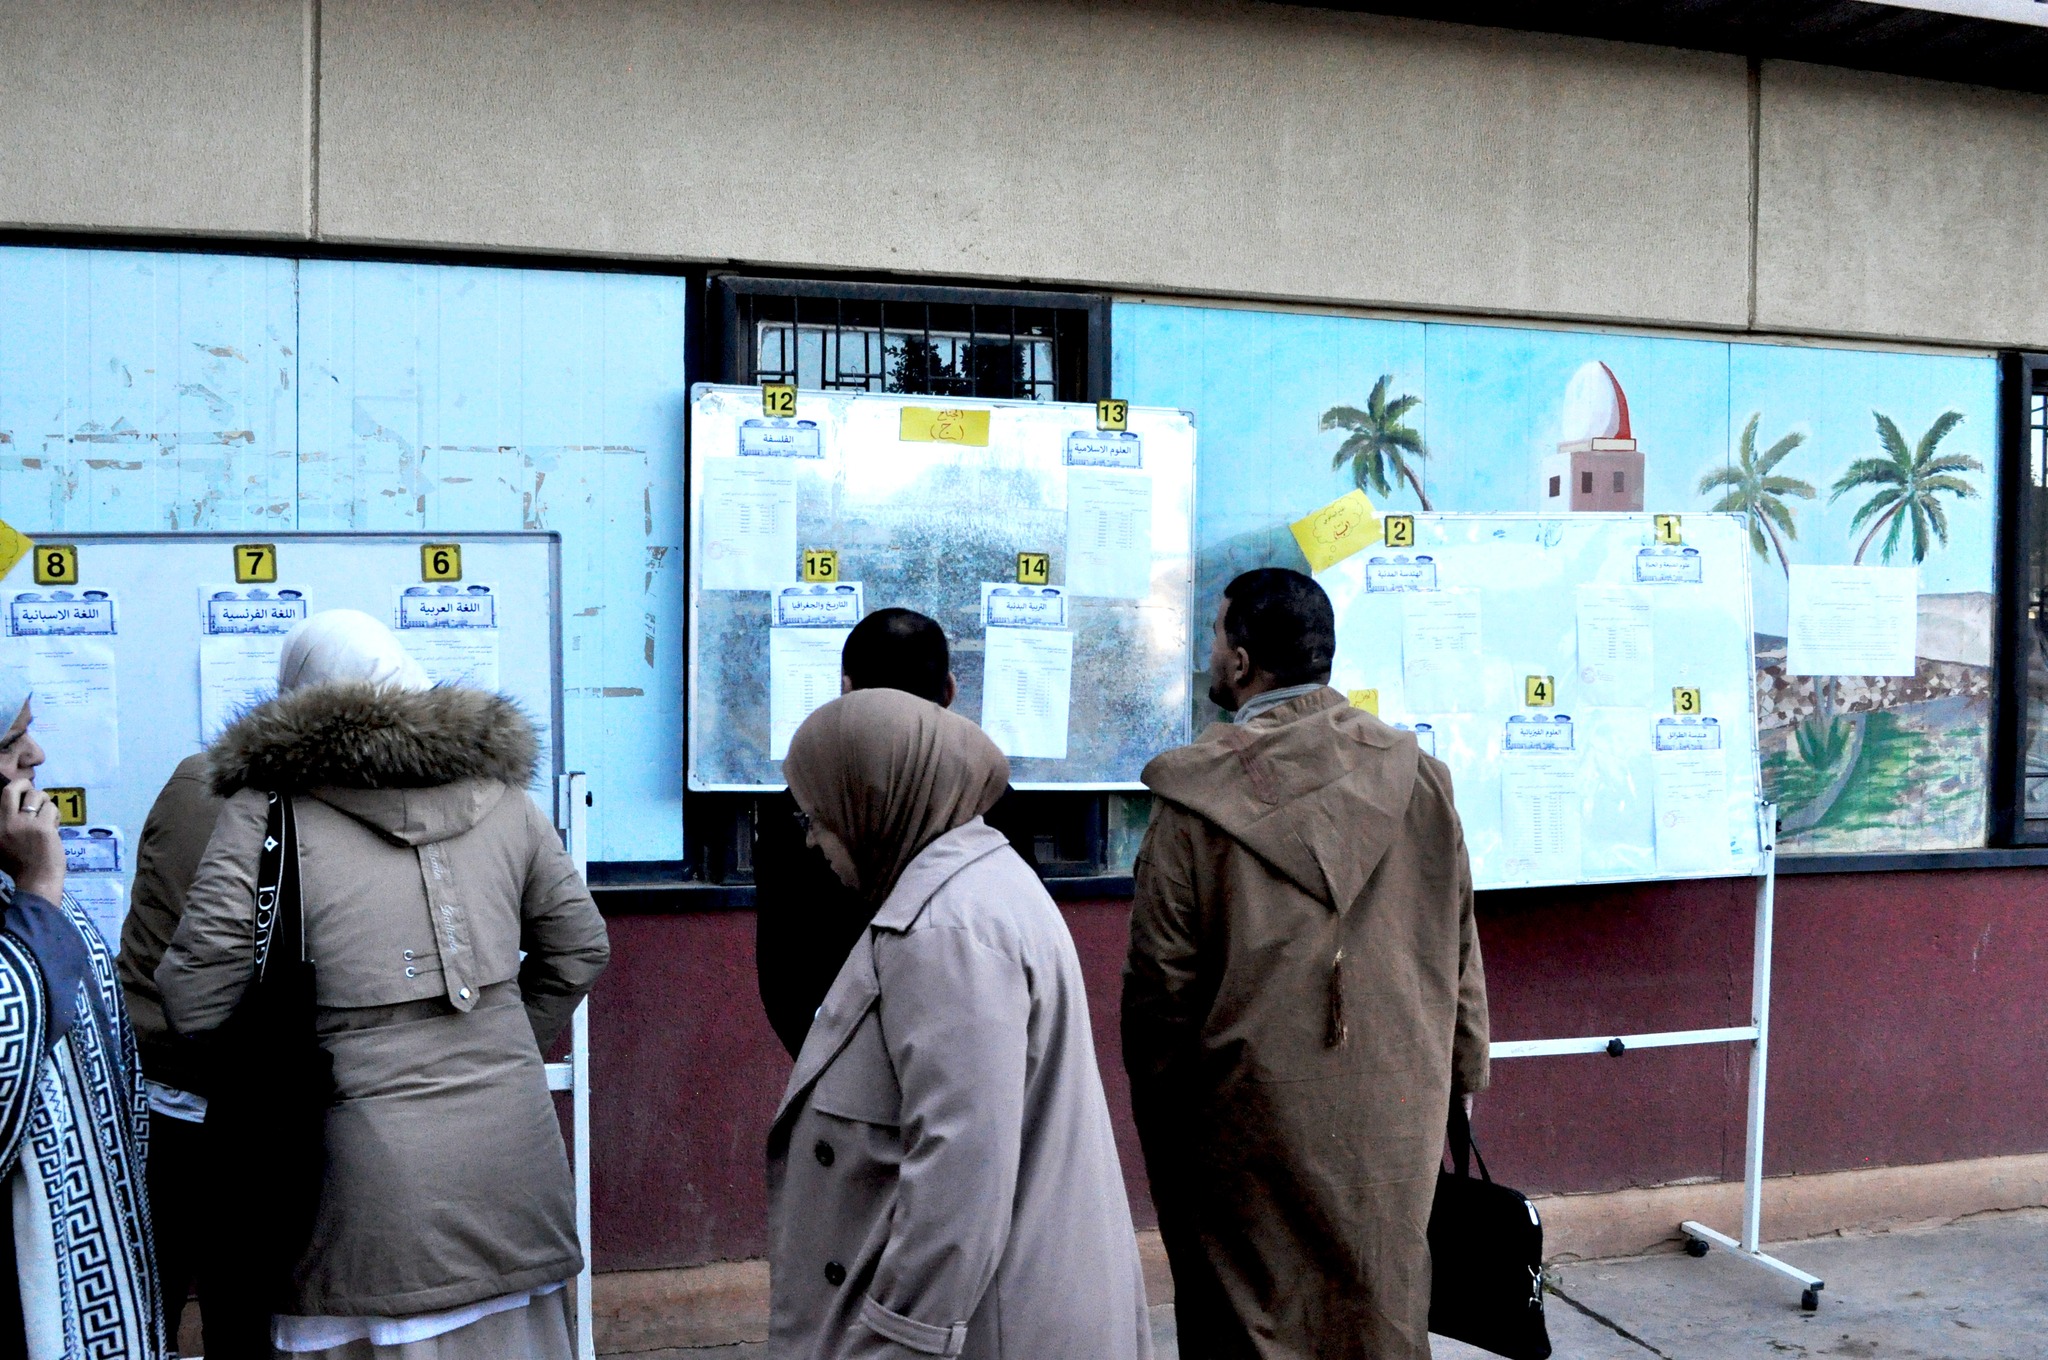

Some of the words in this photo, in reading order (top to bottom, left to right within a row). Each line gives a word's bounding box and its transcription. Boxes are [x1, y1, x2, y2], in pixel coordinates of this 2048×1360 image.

[767, 391, 793, 411] 12
[1101, 403, 1124, 423] 13
[763, 433, 795, 444] الفلسفة
[1109, 446, 1132, 457] العلوم
[1393, 521, 1406, 541] 2
[1663, 520, 1672, 539] 1
[46, 552, 66, 578] 8
[246, 551, 264, 576] 7
[432, 550, 450, 575] 6
[806, 557, 833, 576] 15
[1021, 557, 1046, 577] 14
[22, 608, 70, 623] الاسبانية
[73, 608, 99, 619] اللغة
[222, 608, 268, 622] الفرنسية
[271, 607, 296, 619] اللغة
[419, 602, 454, 616] العربية
[456, 602, 480, 613] اللغة
[825, 601, 849, 612] التاريخ
[1533, 681, 1546, 701] 4
[1681, 691, 1693, 711] 3
[254, 885, 277, 965] GUCCI
